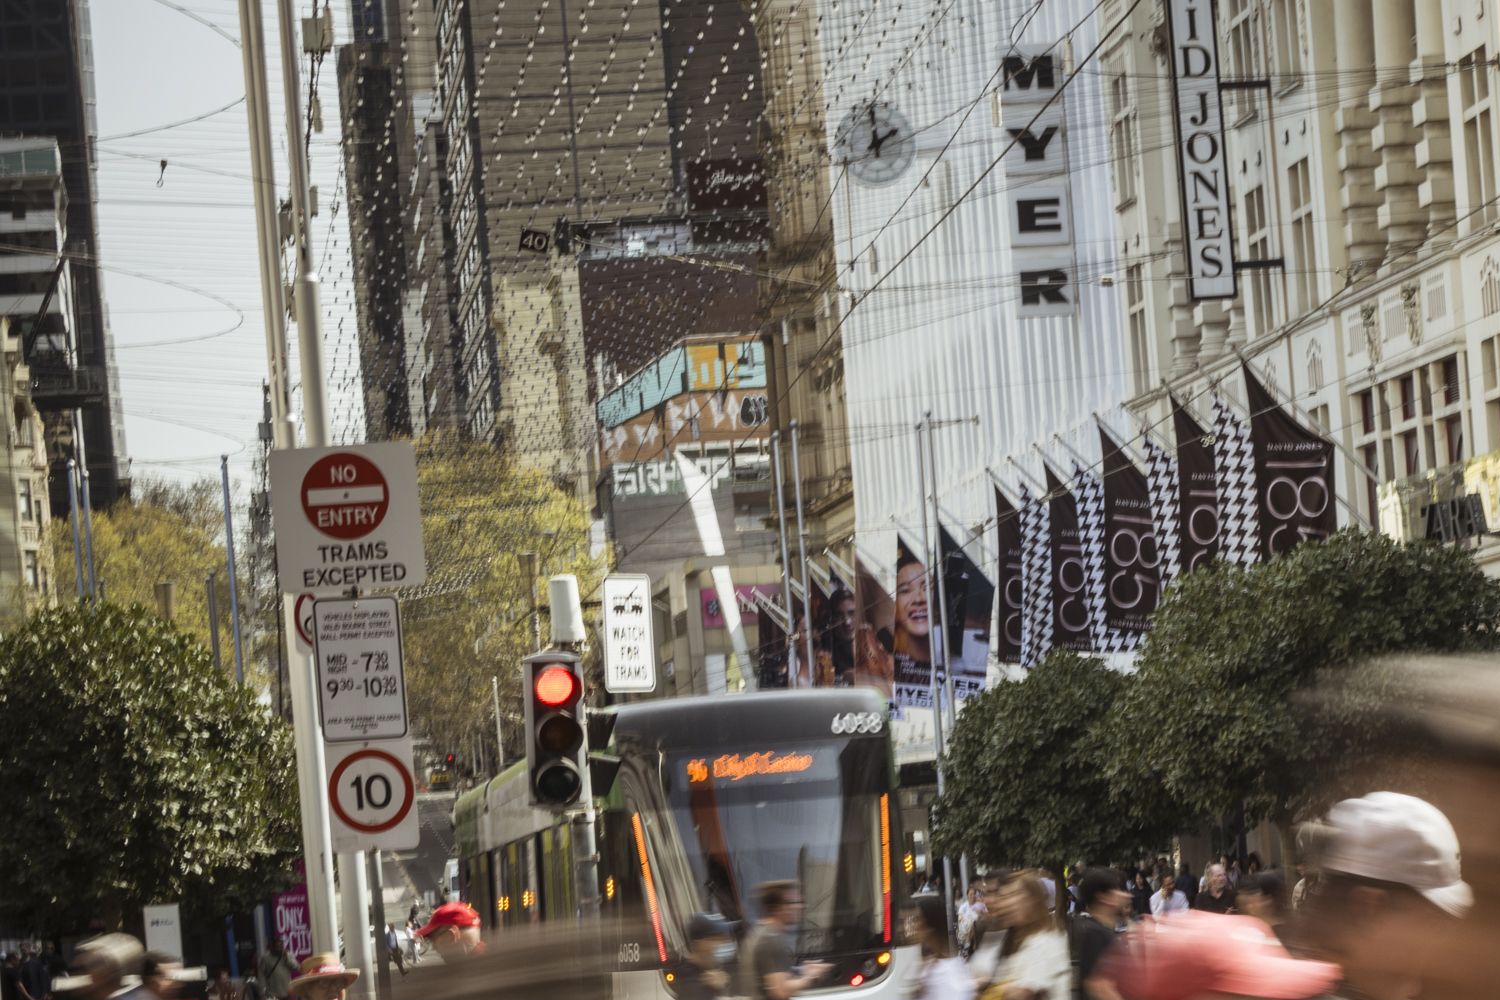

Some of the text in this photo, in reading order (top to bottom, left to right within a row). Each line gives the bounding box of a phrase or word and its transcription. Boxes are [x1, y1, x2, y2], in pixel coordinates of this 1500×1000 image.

[1179, 6, 1224, 279] ID JONES
[1002, 54, 1070, 306] MYER
[522, 232, 547, 251] 40
[1266, 442, 1293, 451] DAVID
[330, 463, 357, 484] NO
[317, 505, 379, 528] ENTRY
[317, 541, 389, 564] TRAMS
[303, 562, 407, 588] EXCEPTED
[363, 629, 395, 639] EXCEPTED
[368, 620, 391, 629] STREET
[613, 626, 645, 642] WATCH
[326, 653, 348, 666] MID
[621, 645, 640, 661] FOR
[615, 664, 648, 681] TRAMS
[350, 772, 393, 811] 10
[276, 904, 307, 934] ONLY
[618, 943, 640, 963] 6058
